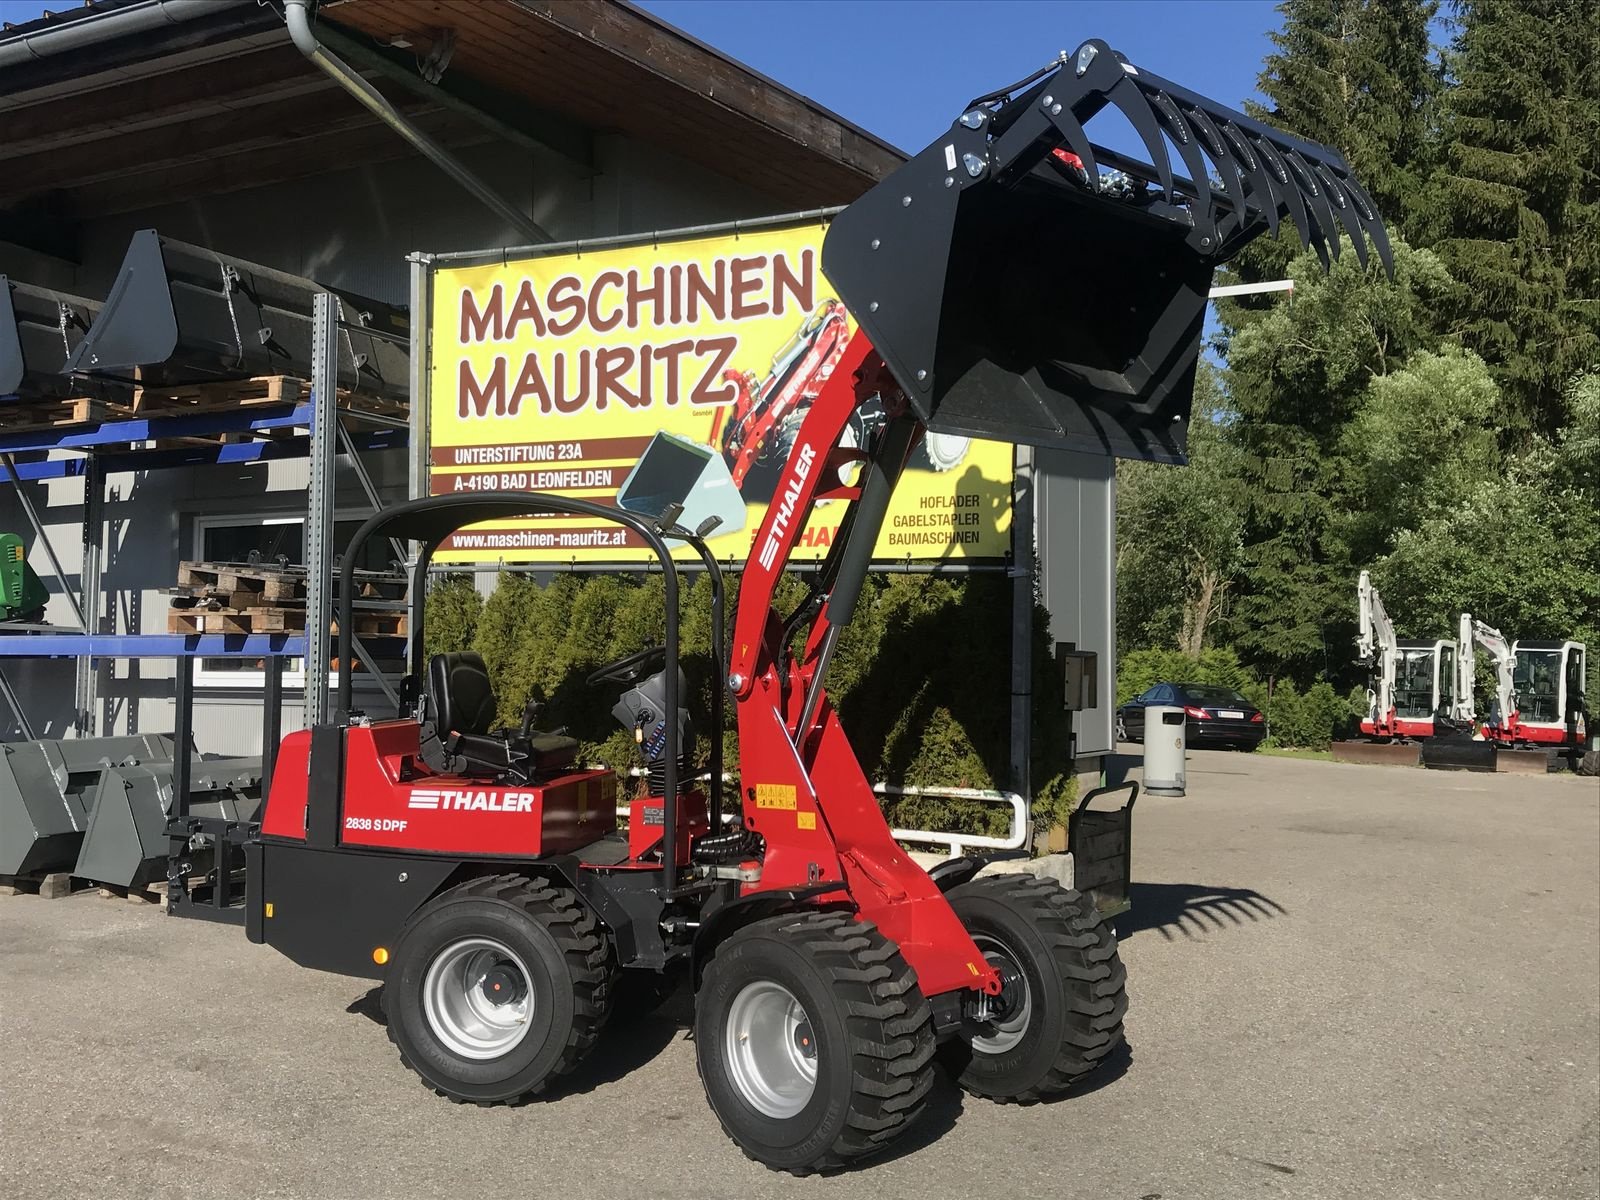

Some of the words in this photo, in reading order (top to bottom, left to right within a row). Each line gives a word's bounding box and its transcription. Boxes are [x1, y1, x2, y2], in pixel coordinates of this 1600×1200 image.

[459, 249, 813, 344] MASCHINEN
[458, 336, 738, 418] MAURITZ
[455, 445, 555, 464] UNTERSTIFTUNG
[558, 443, 583, 460] 23A
[454, 475, 498, 491] A-4190
[501, 473, 527, 489] BAD
[530, 470, 613, 488] LEONFELDEN
[770, 443, 817, 539] THALER
[920, 494, 980, 509] HOFLADER
[893, 513, 980, 528] GABELSTAPLER
[453, 530, 627, 548] www.maschinen-mauritz.at
[889, 531, 980, 546] BAUMASCHINEN
[441, 790, 535, 812] THALER
[346, 817, 372, 830] 2838
